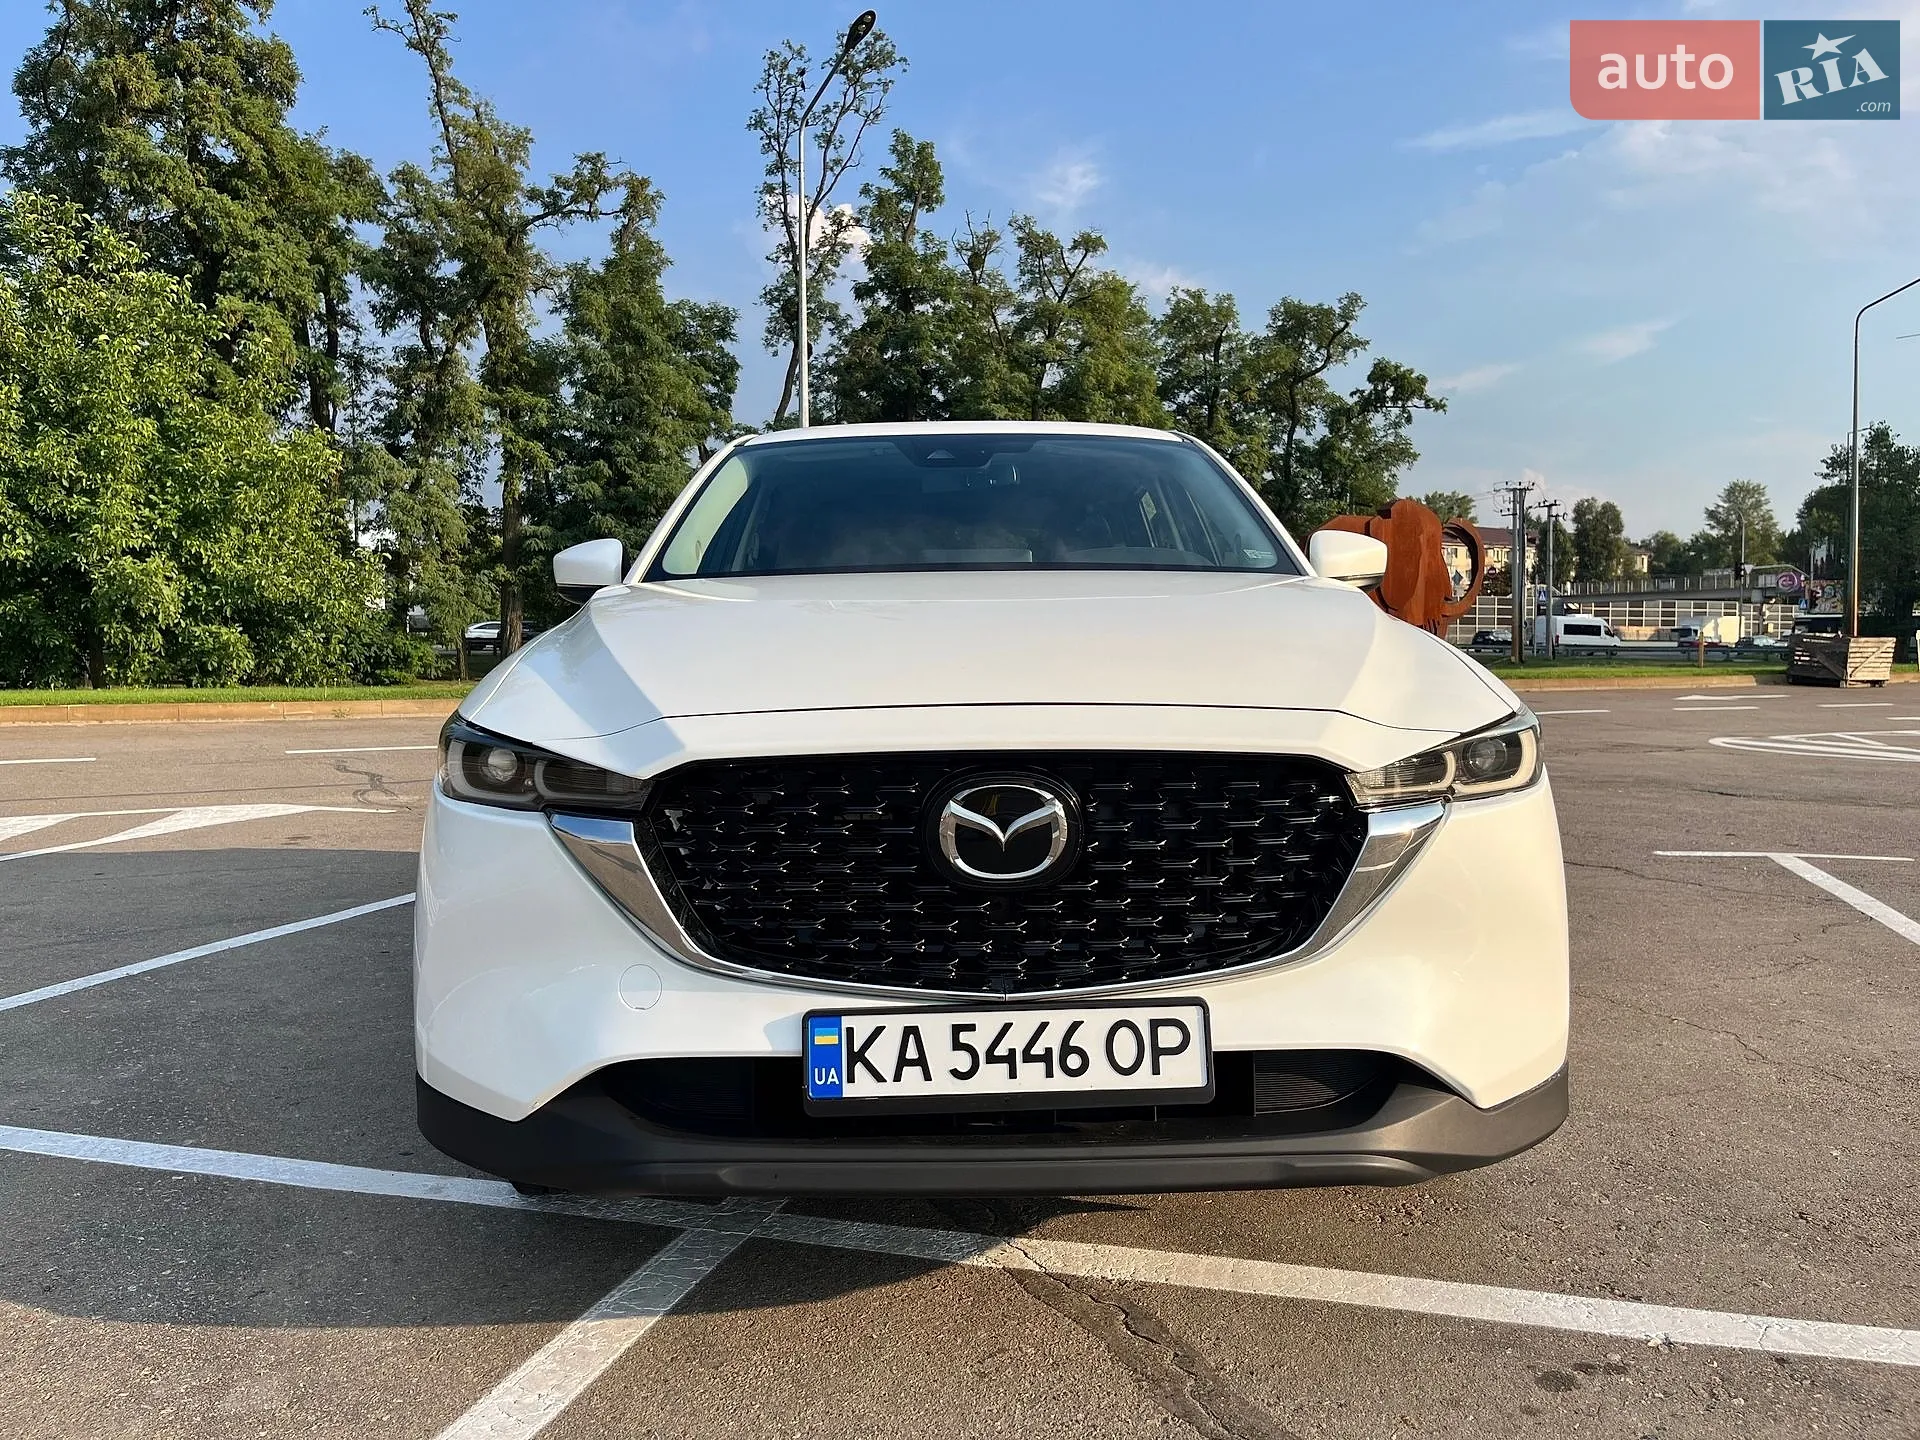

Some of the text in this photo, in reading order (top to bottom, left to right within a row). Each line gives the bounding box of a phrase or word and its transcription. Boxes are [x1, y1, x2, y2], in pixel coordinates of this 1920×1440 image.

[846, 1018, 1191, 1084] KA 5446 OP
[814, 1067, 840, 1085] UA
